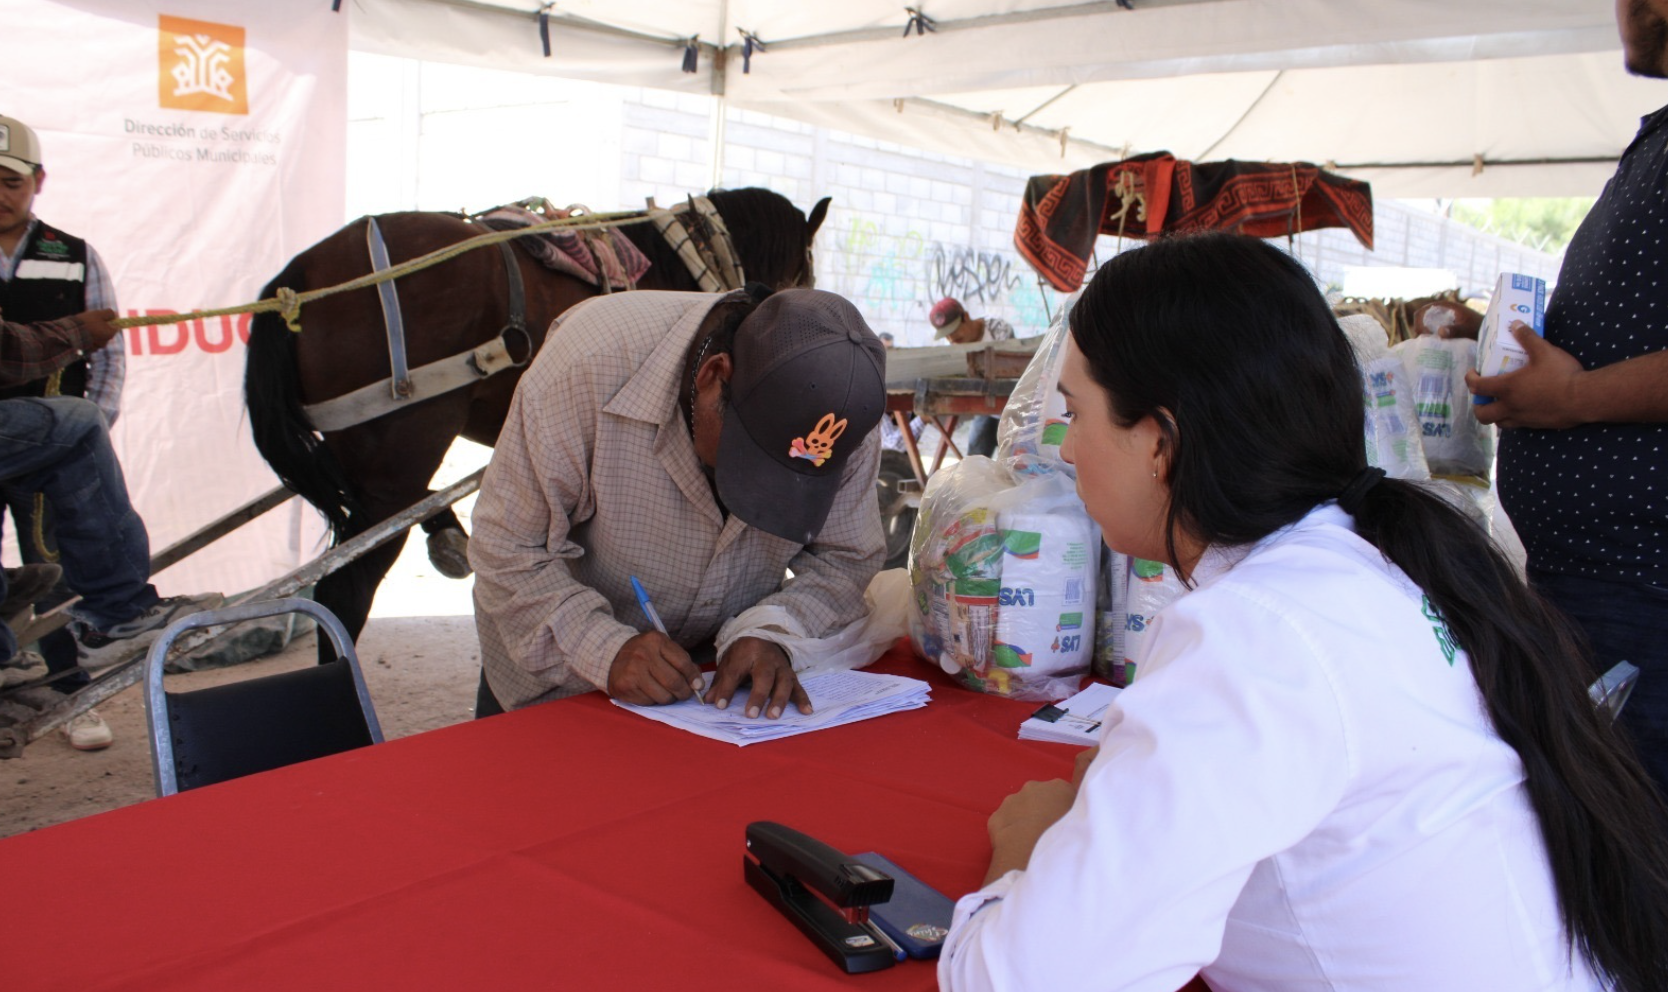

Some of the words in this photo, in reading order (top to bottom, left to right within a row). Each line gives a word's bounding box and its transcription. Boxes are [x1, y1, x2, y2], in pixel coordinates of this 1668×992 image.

[124, 118, 196, 138] Dirección
[200, 128, 217, 141] de
[221, 126, 281, 143] Servicios
[132, 142, 193, 162] Públicos
[196, 147, 277, 167] Municipales
[999, 587, 1034, 606] LYS
[1061, 635, 1081, 653] LYS
